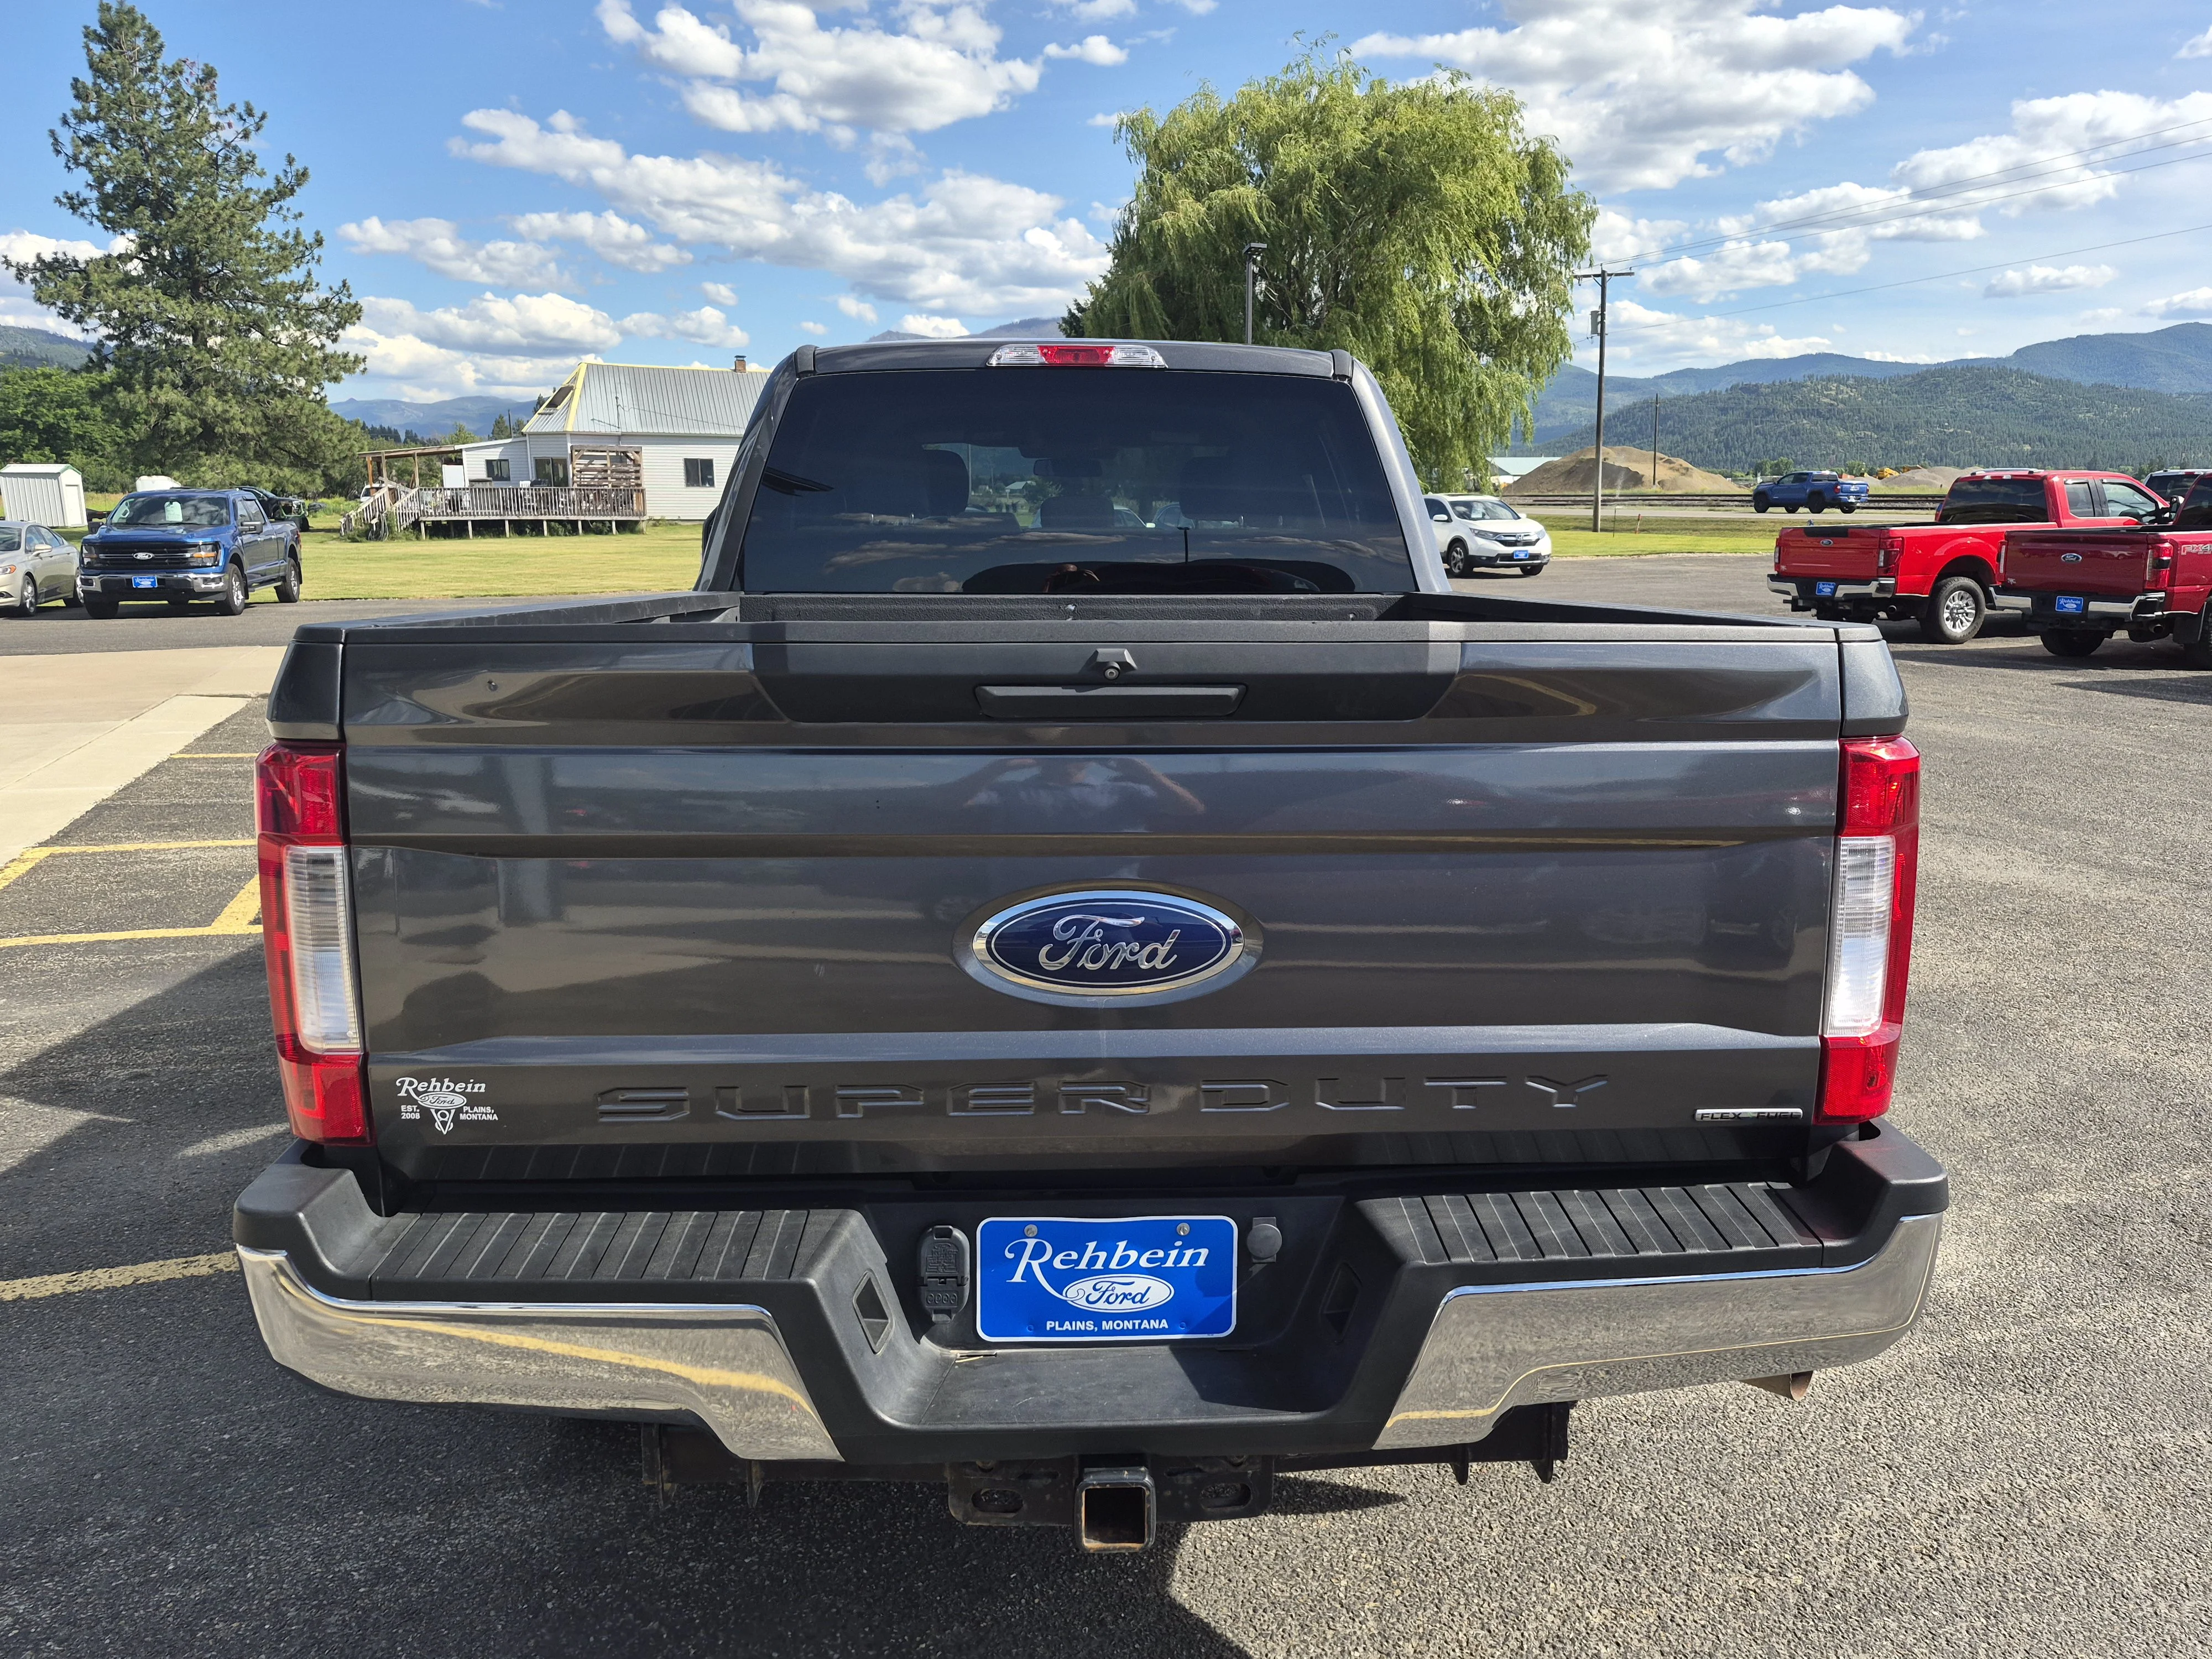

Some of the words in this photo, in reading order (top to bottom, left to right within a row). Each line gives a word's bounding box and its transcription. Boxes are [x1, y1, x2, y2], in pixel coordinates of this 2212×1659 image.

[1039, 914, 1181, 971] Ford
[396, 1077, 486, 1102] Rehbein
[429, 1095, 455, 1105] Ford
[594, 1080, 1150, 1122] SUPER
[1199, 1074, 1609, 1113] DUTY
[1700, 1112, 1742, 1120] FLEX
[1004, 1238, 1209, 1300] Rehbein
[1086, 1280, 1152, 1305] Ford
[1046, 1320, 1098, 1332] PLAINS,
[1102, 1318, 1169, 1331] MONTANA
